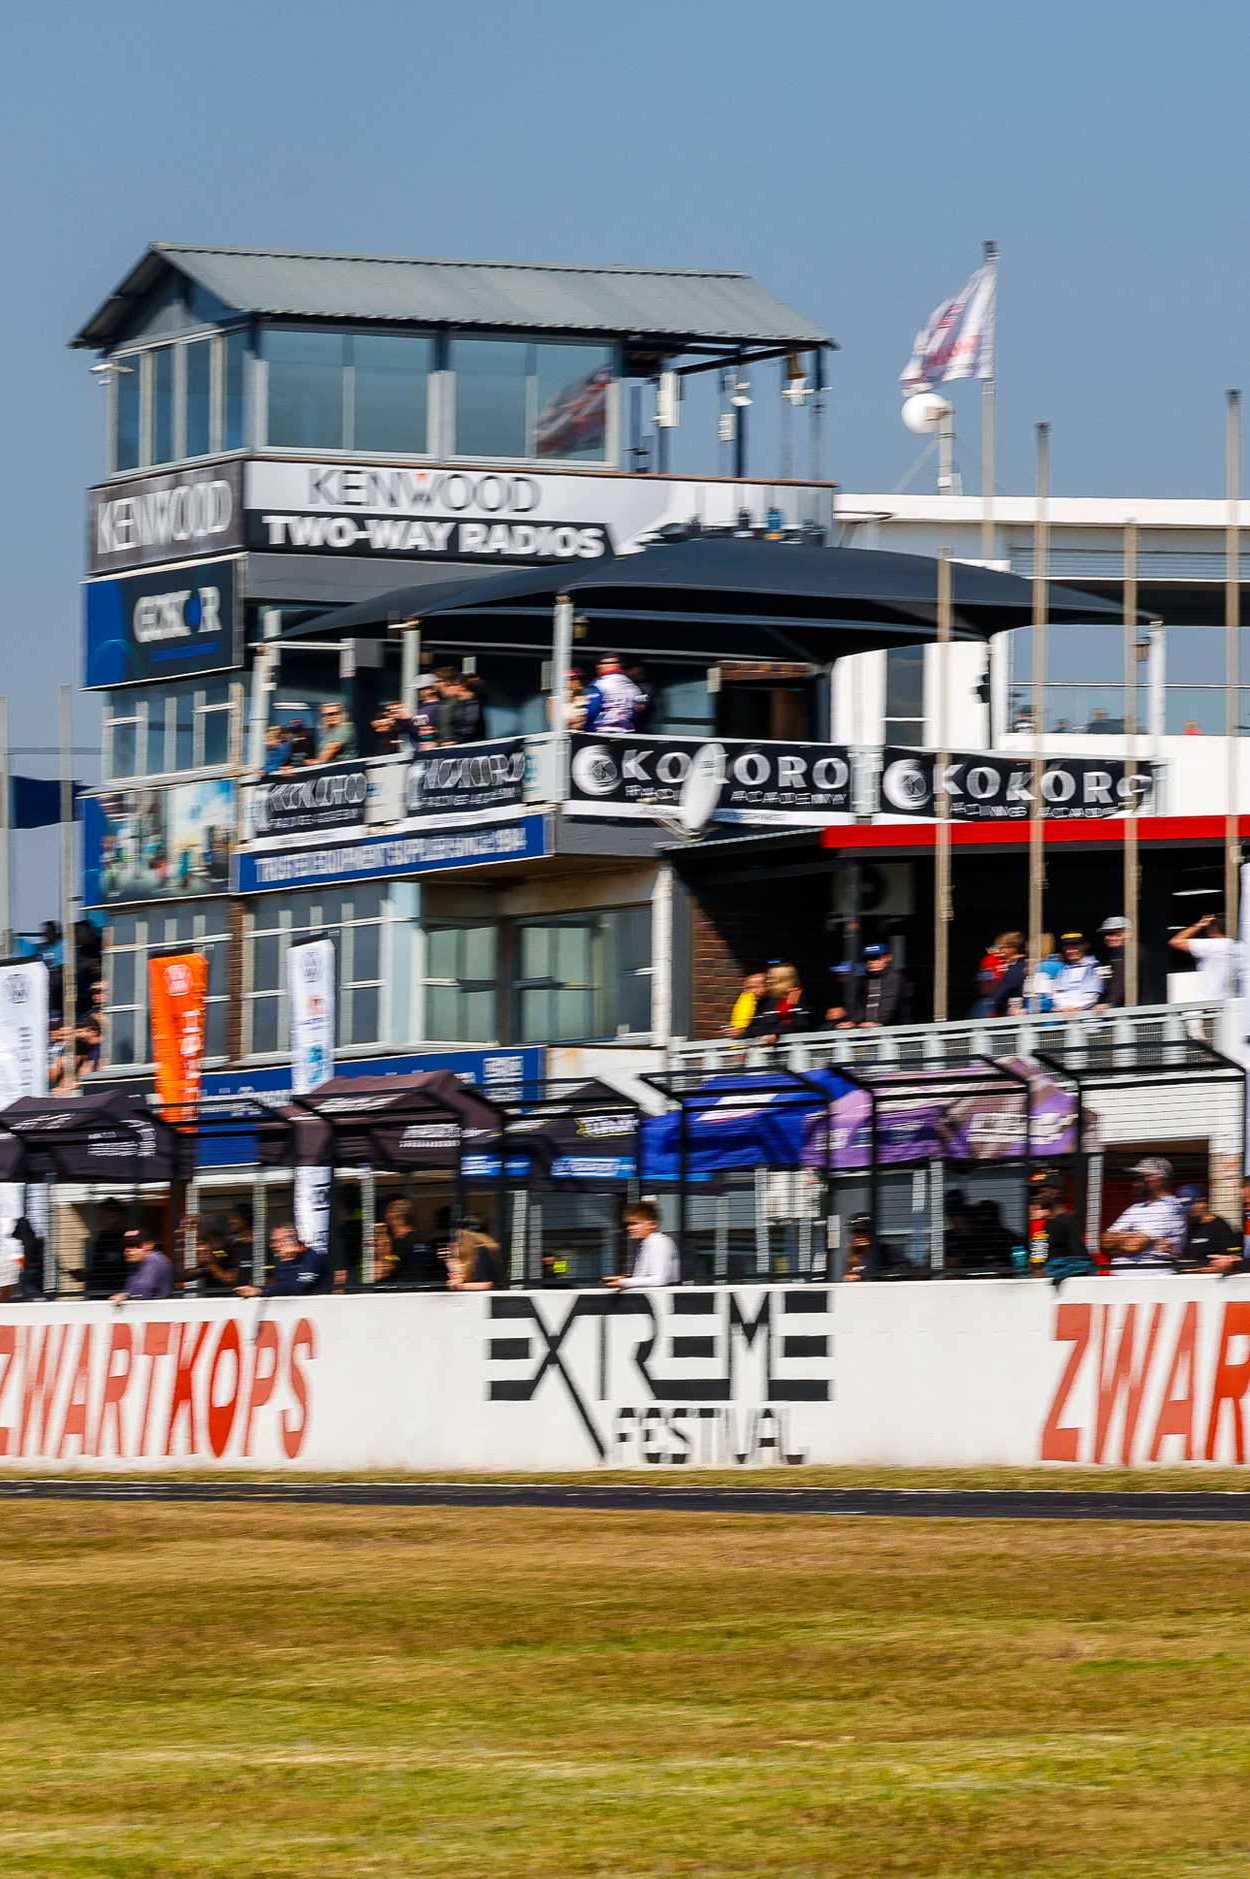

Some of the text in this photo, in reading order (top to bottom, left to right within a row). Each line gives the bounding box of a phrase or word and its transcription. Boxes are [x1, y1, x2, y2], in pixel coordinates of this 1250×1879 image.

[96, 479, 234, 554] KENWOOD
[308, 468, 542, 513] KENWOOD
[262, 515, 606, 558] TWO-WAY RADIOS
[485, 1291, 834, 1466] EXTREME
